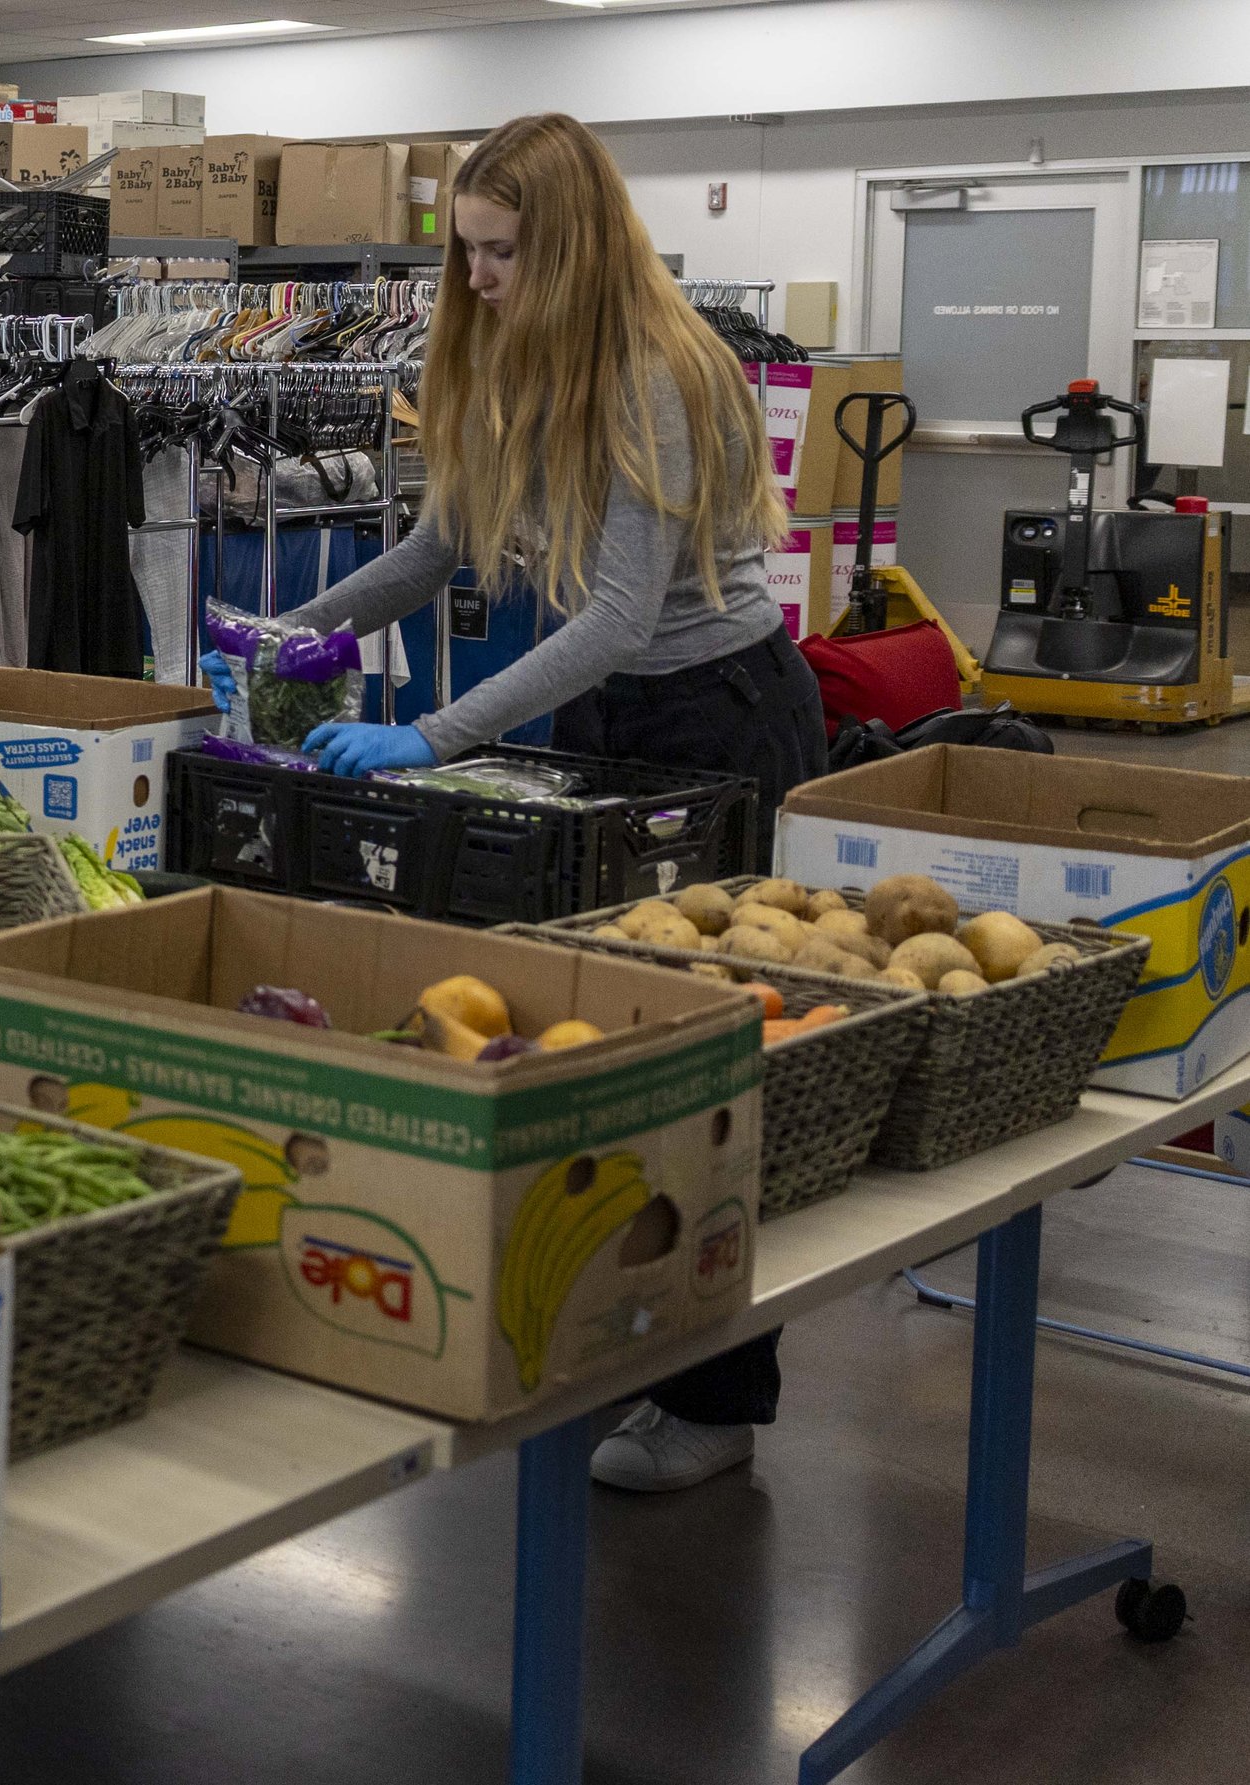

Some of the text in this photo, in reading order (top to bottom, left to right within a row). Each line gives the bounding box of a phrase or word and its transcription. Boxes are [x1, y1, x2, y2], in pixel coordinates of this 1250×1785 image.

[36, 103, 58, 114] HUGGI
[117, 170, 142, 182] Baby
[162, 167, 191, 179] Baby
[208, 162, 236, 175] Baby
[4, 741, 68, 757] CLASS EXTRA
[4, 753, 73, 765] SELECTED QUALITY
[124, 814, 161, 834] ever
[116, 834, 156, 857] snack
[126, 852, 158, 871] best
[5, 1029, 107, 1073] CERTIFIED
[123, 1055, 234, 1102] BANANAS
[348, 1104, 472, 1151] CERTIFIED
[300, 1251, 413, 1323] Dole
